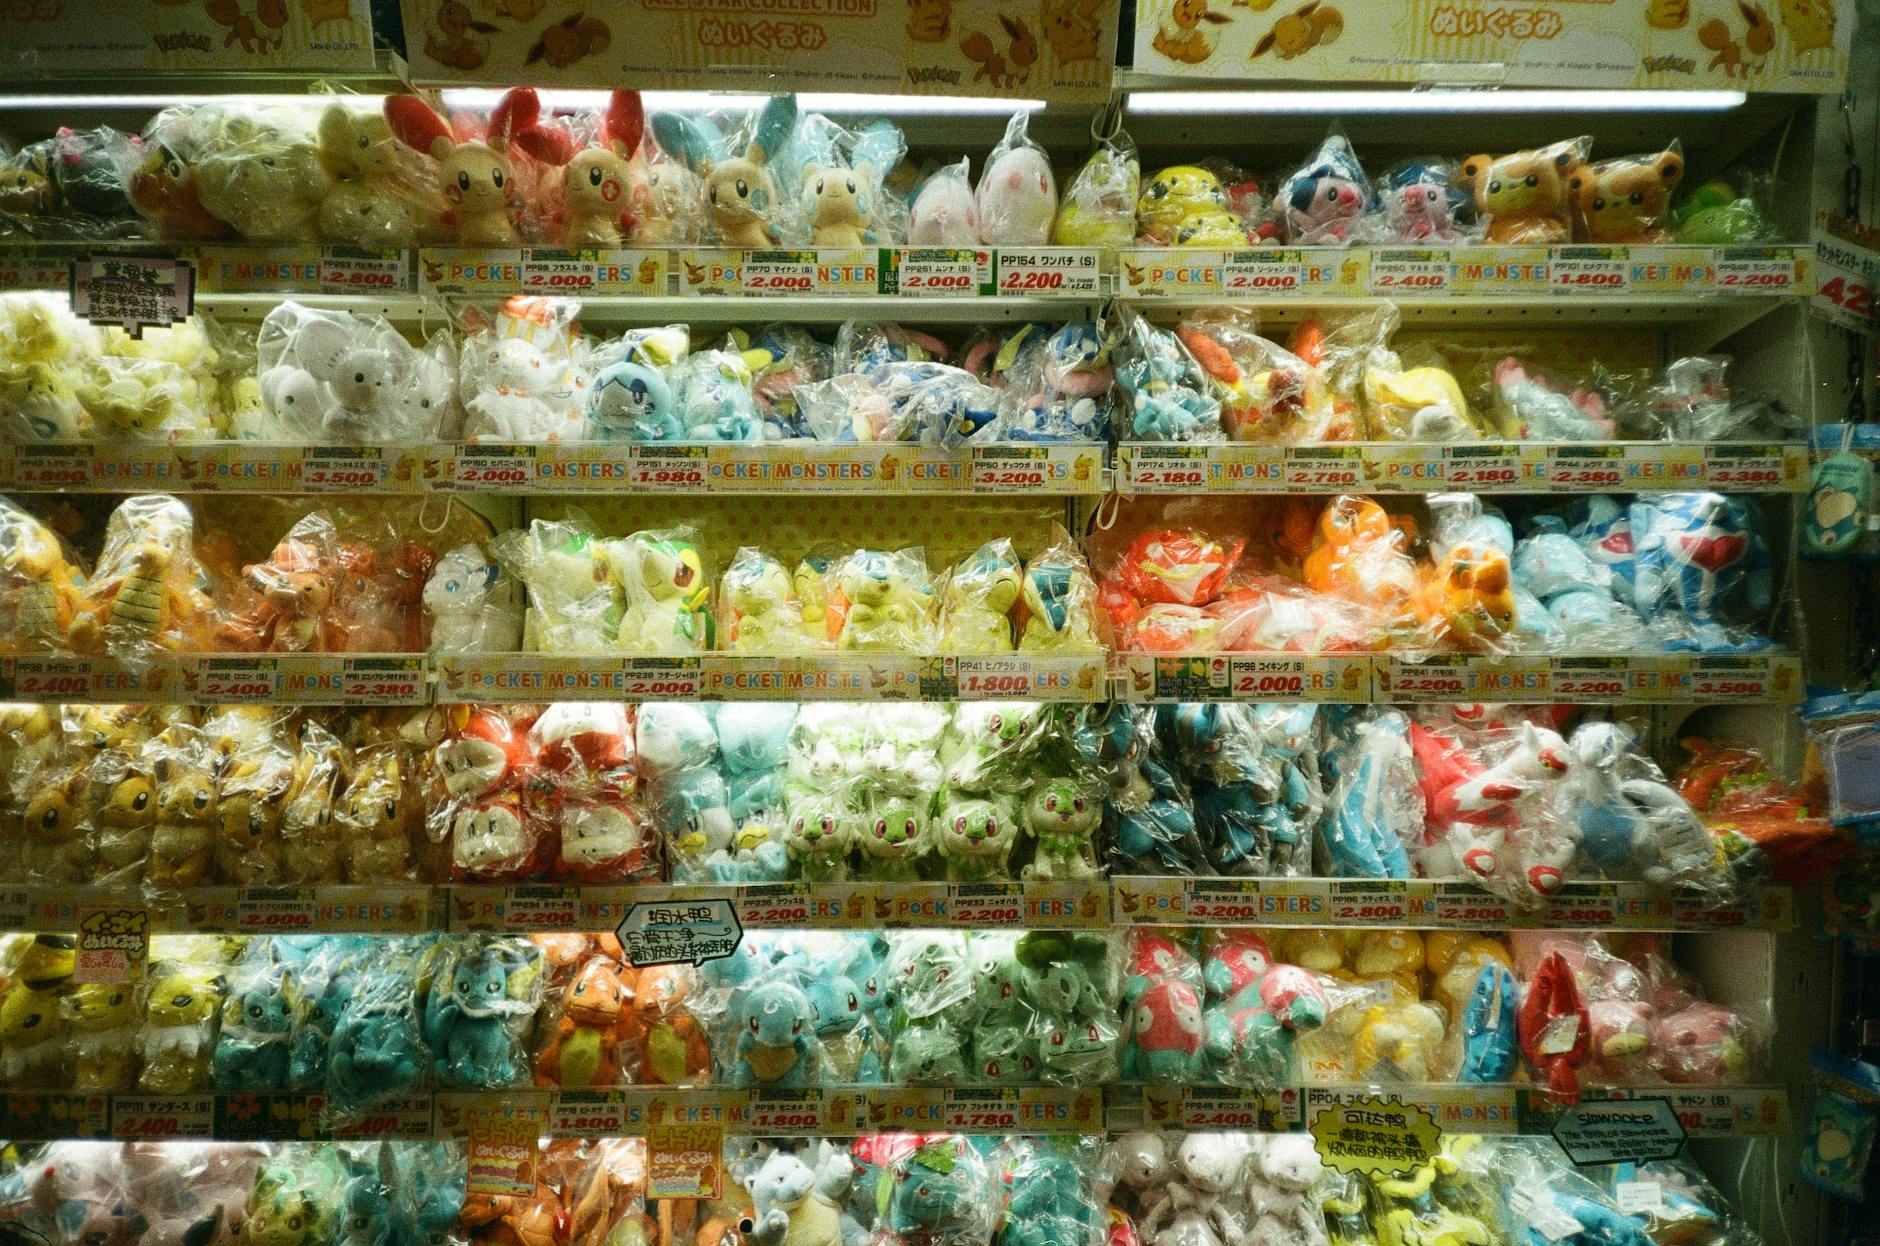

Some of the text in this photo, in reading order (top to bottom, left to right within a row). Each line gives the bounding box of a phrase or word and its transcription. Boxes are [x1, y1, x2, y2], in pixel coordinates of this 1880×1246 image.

[1432, 9, 1562, 38] ぬいぐるみ
[701, 20, 824, 48] ぬいぐるみ
[552, 264, 594, 272] プラスル (S)
[1001, 255, 1096, 267] PP154 ワンパチ (S)
[236, 263, 321, 281] MONSTE
[451, 264, 523, 283] POCKET
[747, 265, 813, 274] PP70 マイナン (S)
[905, 265, 932, 273] PP251
[935, 265, 955, 273] ムンナ
[958, 265, 971, 274] (S)
[1150, 267, 1225, 284] POCKET
[1465, 264, 1550, 281] MONSTE
[93, 461, 173, 478] MONSTE
[203, 461, 280, 479] POCKET
[536, 462, 626, 480] ONSTERS
[775, 462, 875, 480] MONSTERS
[1034, 462, 1046, 470] (S)
[1189, 462, 1201, 470] (S)
[79, 662, 91, 673] (S)
[960, 661, 1031, 671] PP41 ヒノアラシ (S)
[1259, 661, 1289, 671] コイキング
[1293, 661, 1304, 672] (S)
[471, 672, 623, 690] POCKET MONSTE
[711, 672, 861, 689] POCKET MONSTE
[1218, 1102, 1240, 1110] ポリゴン
[1309, 1093, 1341, 1104] PP04
[1712, 1094, 1730, 1106] (S)
[148, 1101, 211, 1113] サンダース (S)
[970, 1103, 1002, 1111] フシギダネ
[1343, 1110, 1407, 1129] 可达鸭
[475, 1144, 529, 1160] ぬいぐるみ
[654, 1151, 713, 1166] ぬいぐるみ
